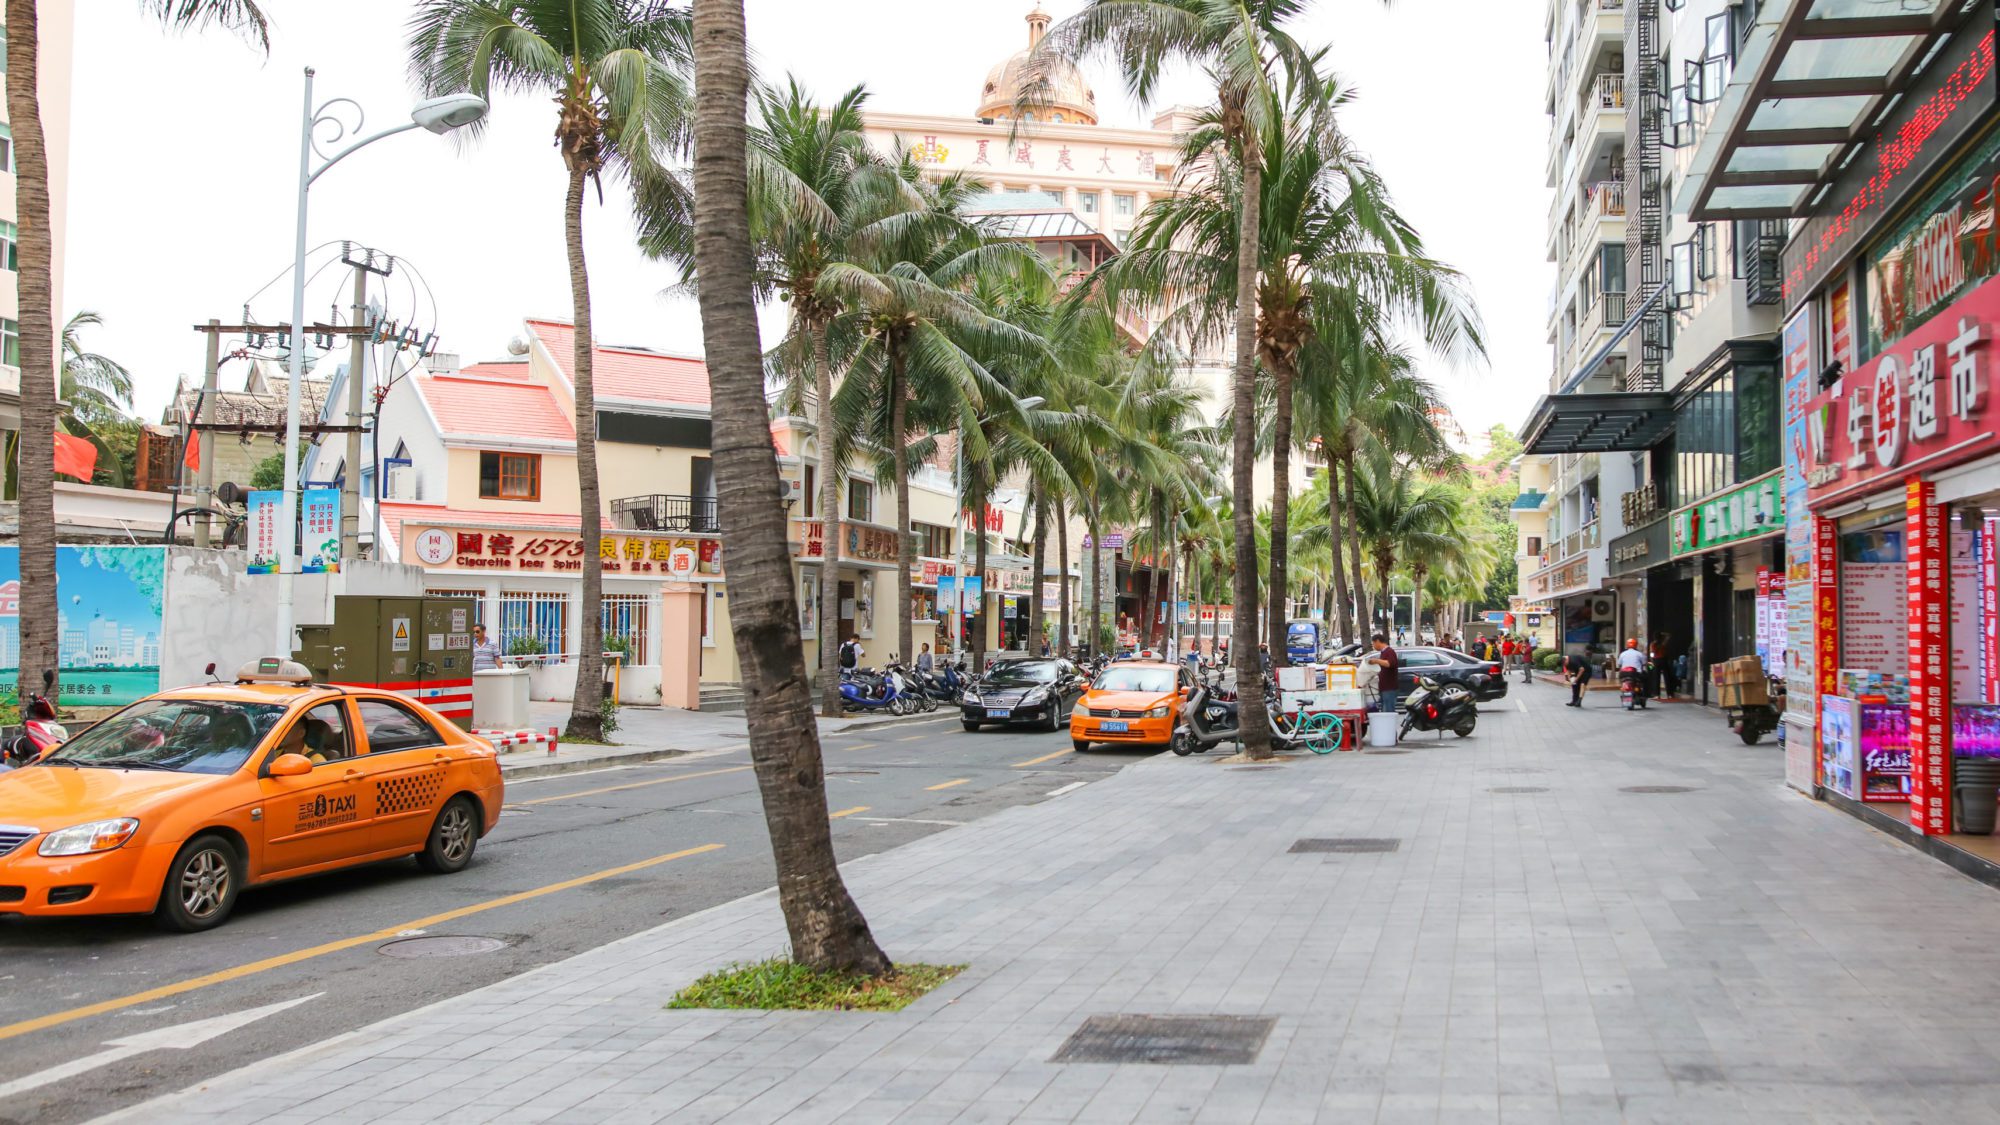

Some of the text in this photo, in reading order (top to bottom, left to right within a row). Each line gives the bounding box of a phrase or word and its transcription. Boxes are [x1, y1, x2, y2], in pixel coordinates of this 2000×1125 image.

[1847, 318, 1980, 470] 生鲜超市
[456, 557, 511, 568] Cigarette
[520, 559, 544, 568] Beer
[673, 553, 688, 571] 酒
[328, 794, 355, 814] TAXI
